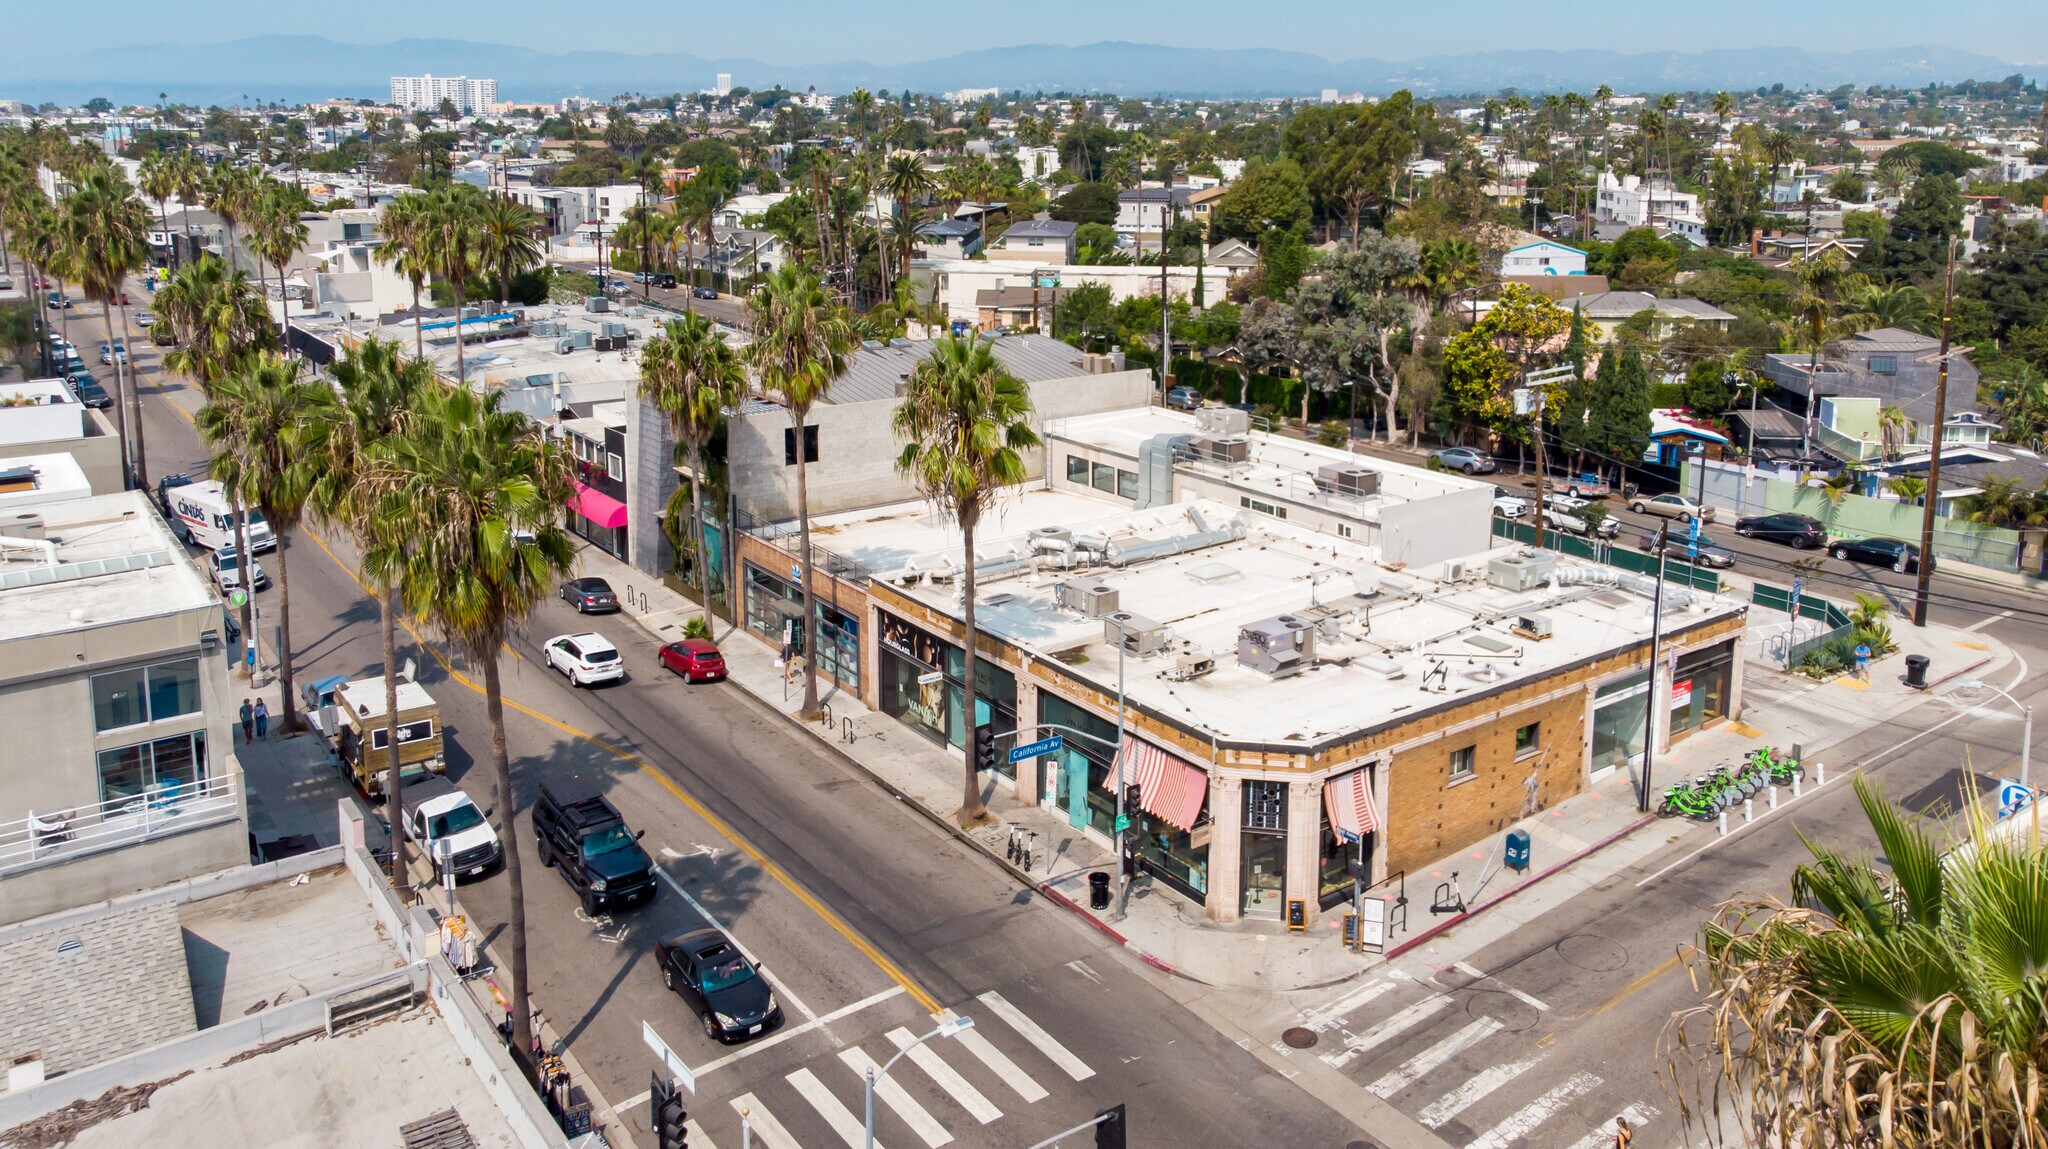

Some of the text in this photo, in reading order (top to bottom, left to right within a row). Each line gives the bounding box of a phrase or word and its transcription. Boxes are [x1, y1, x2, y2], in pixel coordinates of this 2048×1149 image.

[178, 498, 204, 521] CINTAS
[1013, 740, 1060, 759] California Av
